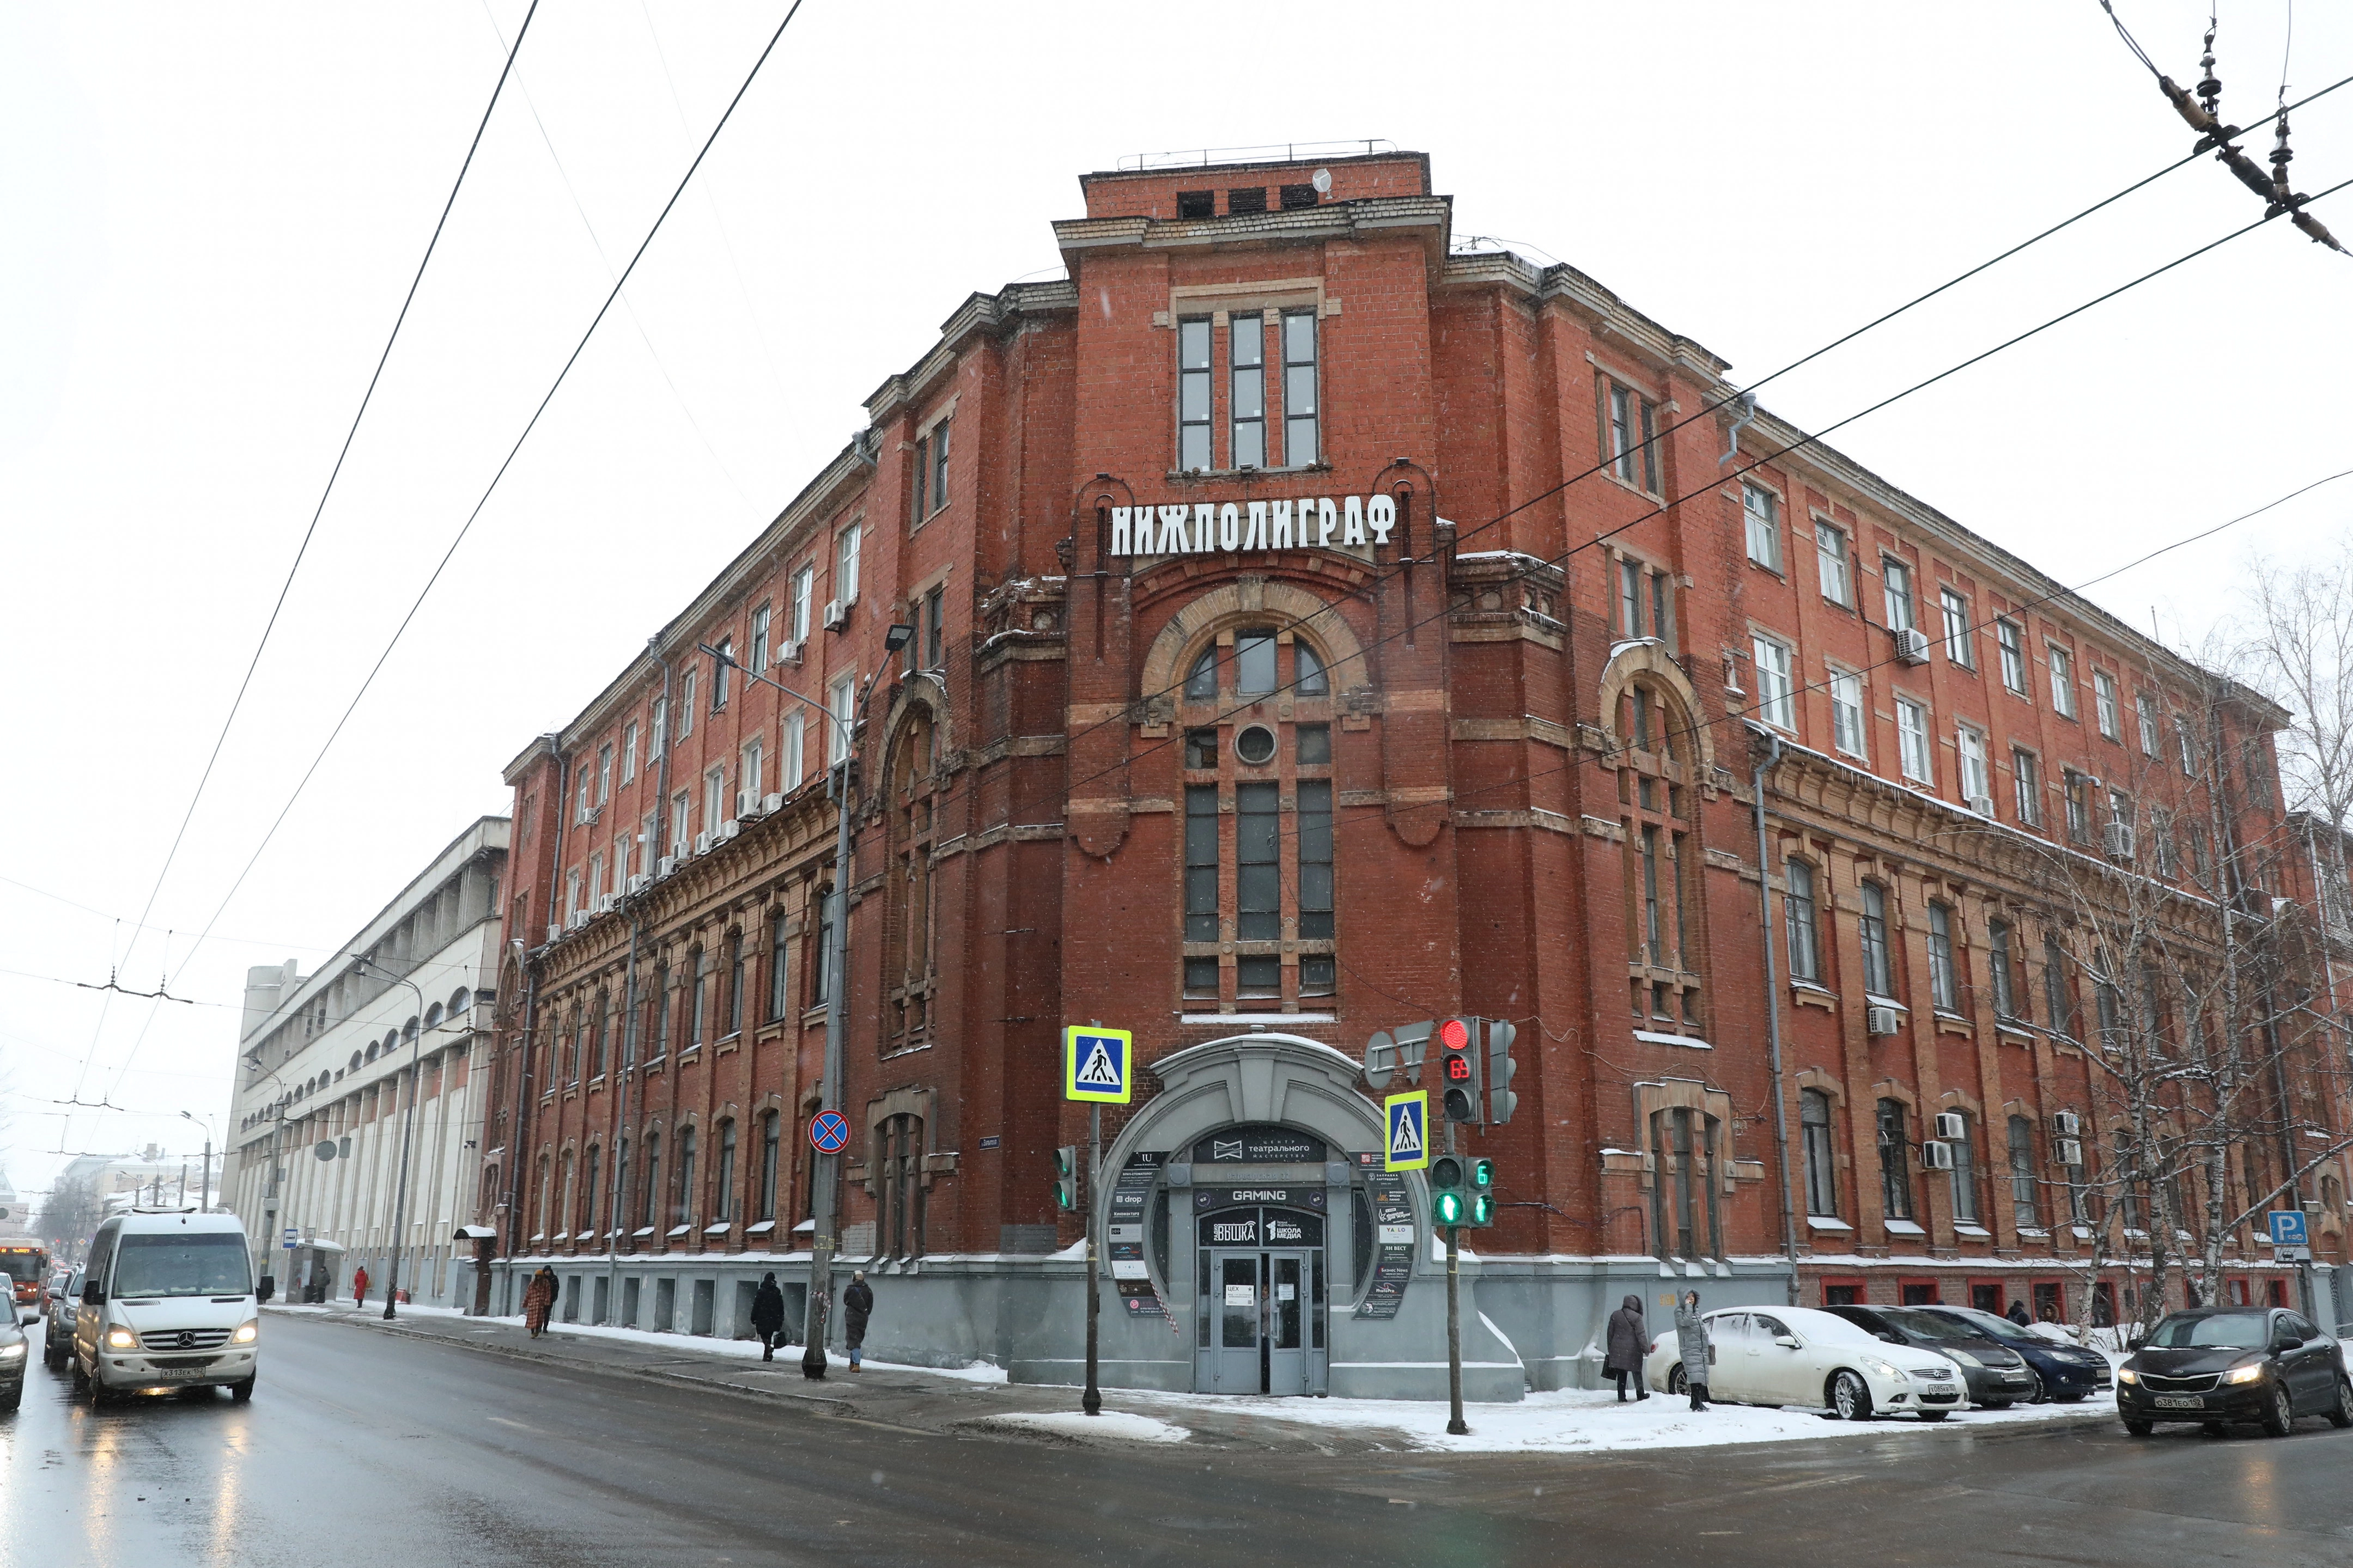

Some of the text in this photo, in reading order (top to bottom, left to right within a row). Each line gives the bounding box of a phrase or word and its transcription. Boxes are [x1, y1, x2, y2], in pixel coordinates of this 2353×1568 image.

[1110, 493, 1396, 556] НИЖПОЛИГРАФ
[1249, 1145, 1310, 1154] театрального
[1227, 1173, 1277, 1181] Варварская
[1478, 1166, 1488, 1185] 6
[1124, 1195, 1142, 1204] drop
[1233, 1191, 1286, 1200] GAMING
[2277, 1216, 2297, 1241] P
[2156, 1399, 2188, 1407] О381ЕО
